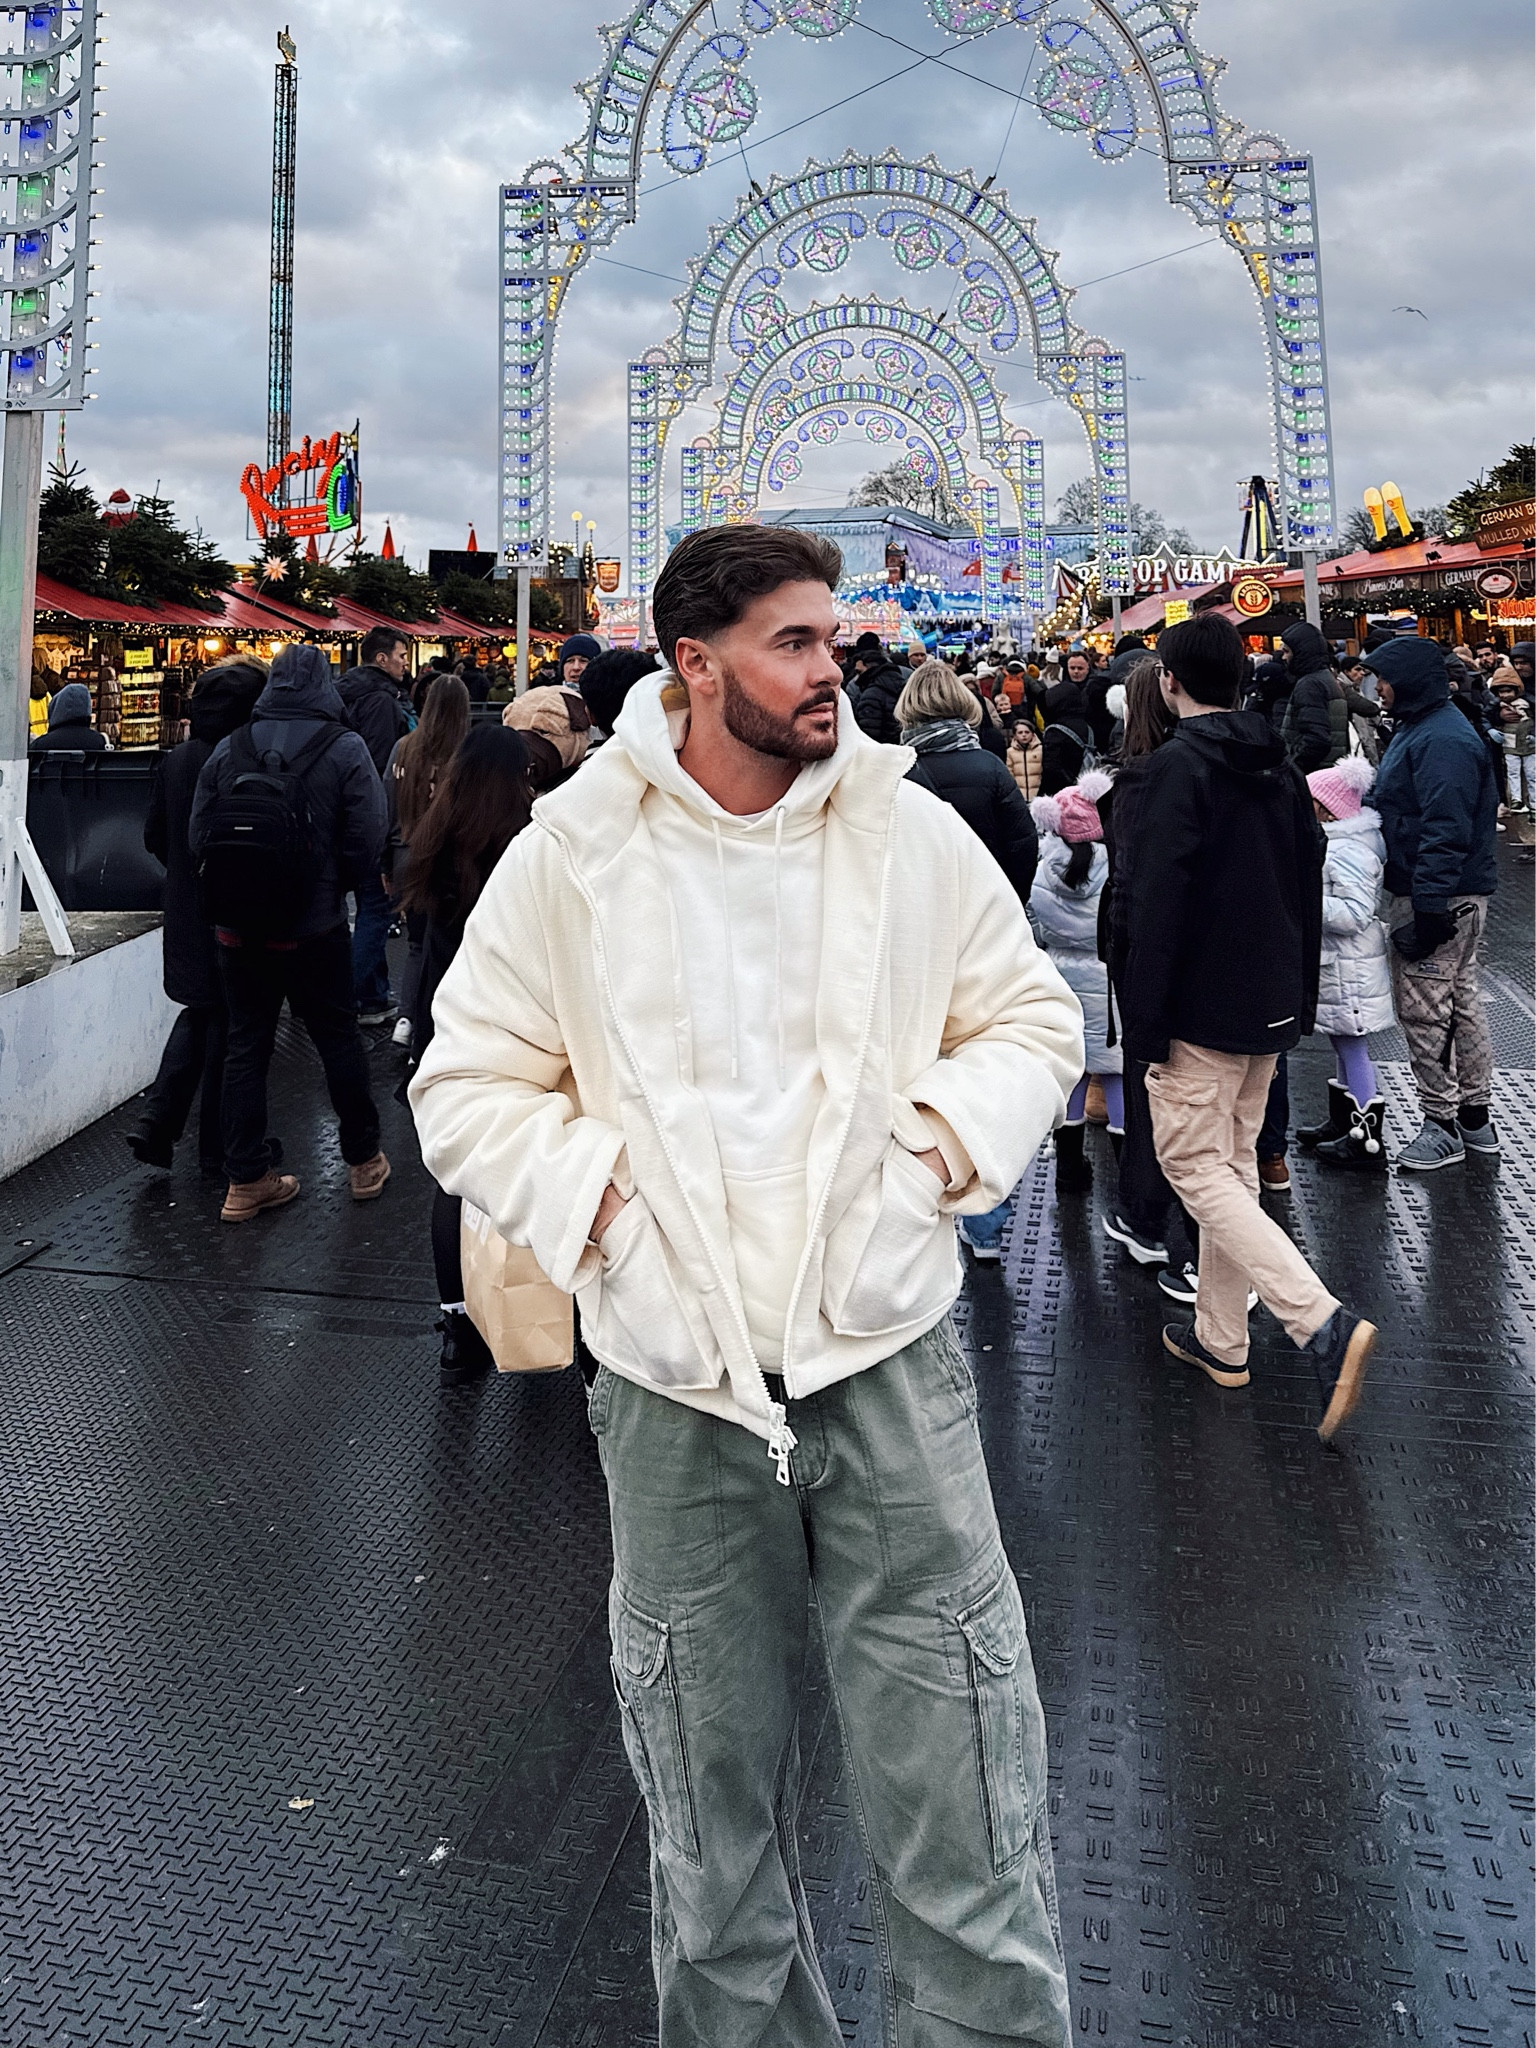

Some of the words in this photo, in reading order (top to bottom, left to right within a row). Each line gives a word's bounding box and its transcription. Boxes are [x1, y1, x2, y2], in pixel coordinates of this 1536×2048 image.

[1480, 505, 1524, 526] GERMAN
[1479, 527, 1520, 544] MULLED
[1131, 559, 1168, 583] OP
[1445, 569, 1473, 586] GERMAN
